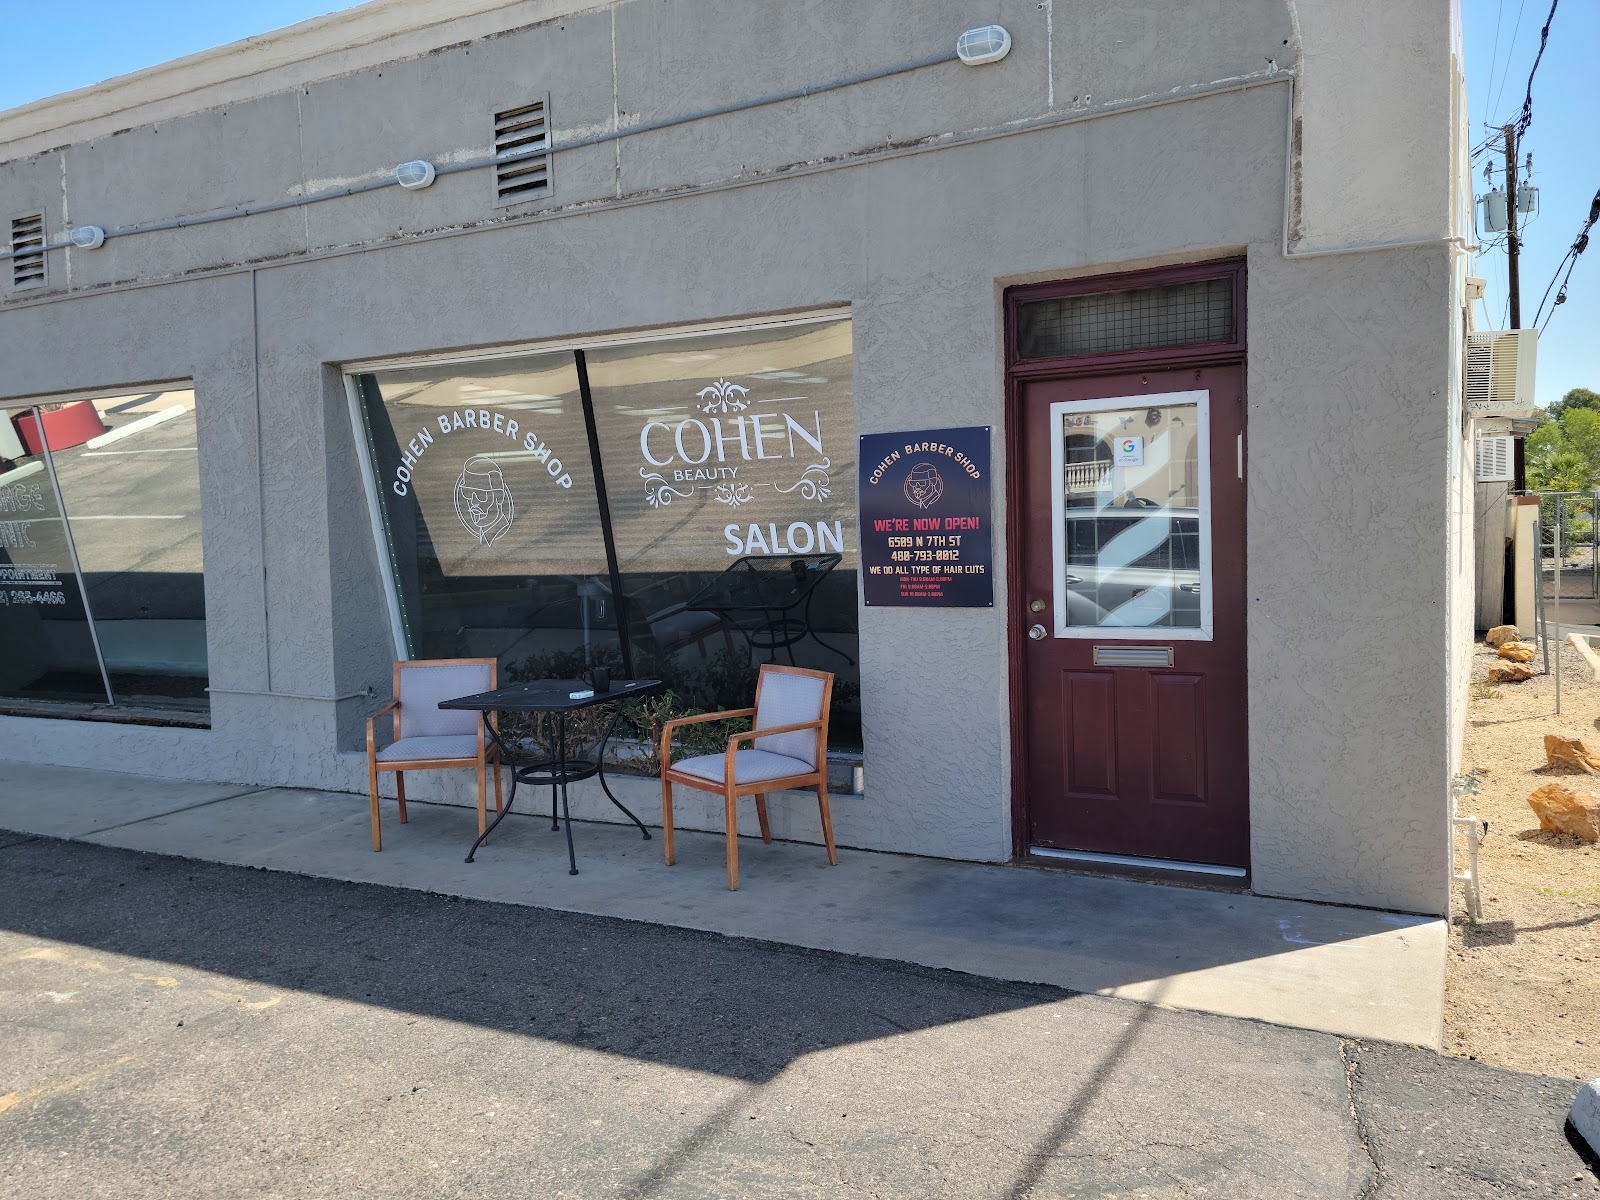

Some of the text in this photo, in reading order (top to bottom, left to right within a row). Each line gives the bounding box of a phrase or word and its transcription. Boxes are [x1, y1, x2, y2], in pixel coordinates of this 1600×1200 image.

[640, 410, 823, 466] COHEN
[393, 409, 573, 497] COHEN BARBER SHOP
[869, 442, 980, 485] COHEN BARBER SHOP
[674, 467, 738, 481] BEAUTY
[874, 516, 980, 532] WE'RE NOW OPEN!
[724, 520, 844, 555] SALON
[916, 537, 923, 547] N
[926, 536, 946, 547] 7TH
[949, 535, 961, 547] ST
[891, 550, 959, 562] 480-793-0012
[869, 565, 985, 575] WE DO ALL TYPE OF HAIR CUTS
